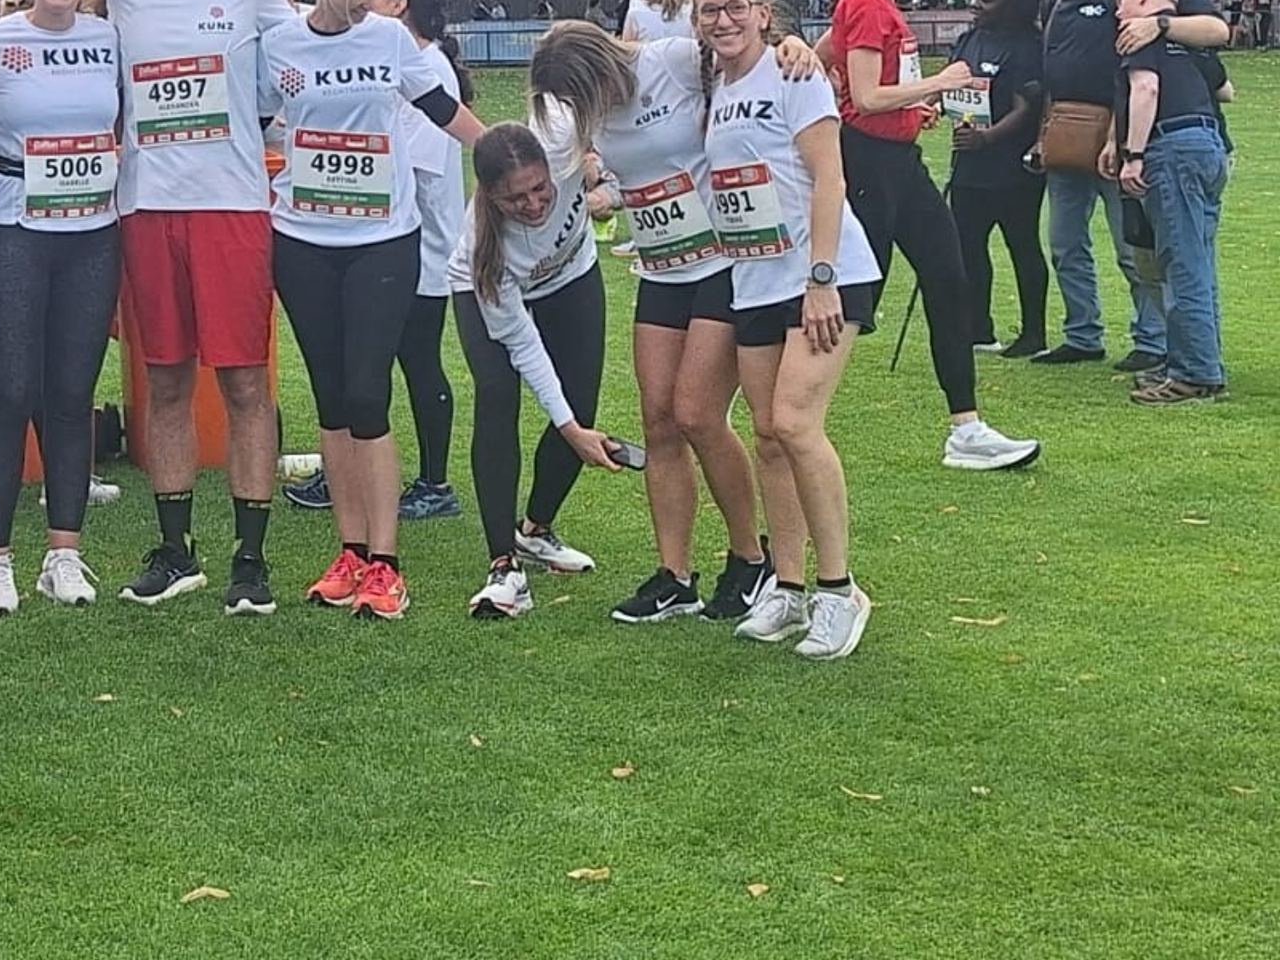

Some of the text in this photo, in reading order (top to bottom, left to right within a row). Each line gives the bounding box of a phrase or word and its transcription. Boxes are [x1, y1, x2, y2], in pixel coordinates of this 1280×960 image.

[198, 22, 234, 30] KUNZ
[43, 48, 114, 65] KUNZ
[315, 65, 392, 86] KUNZ
[148, 78, 207, 102] 4997
[635, 105, 670, 126] KUNZ
[714, 100, 774, 126] KUNZ
[45, 155, 102, 178] 5006
[311, 153, 374, 176] 4998
[632, 200, 685, 231] 5004
